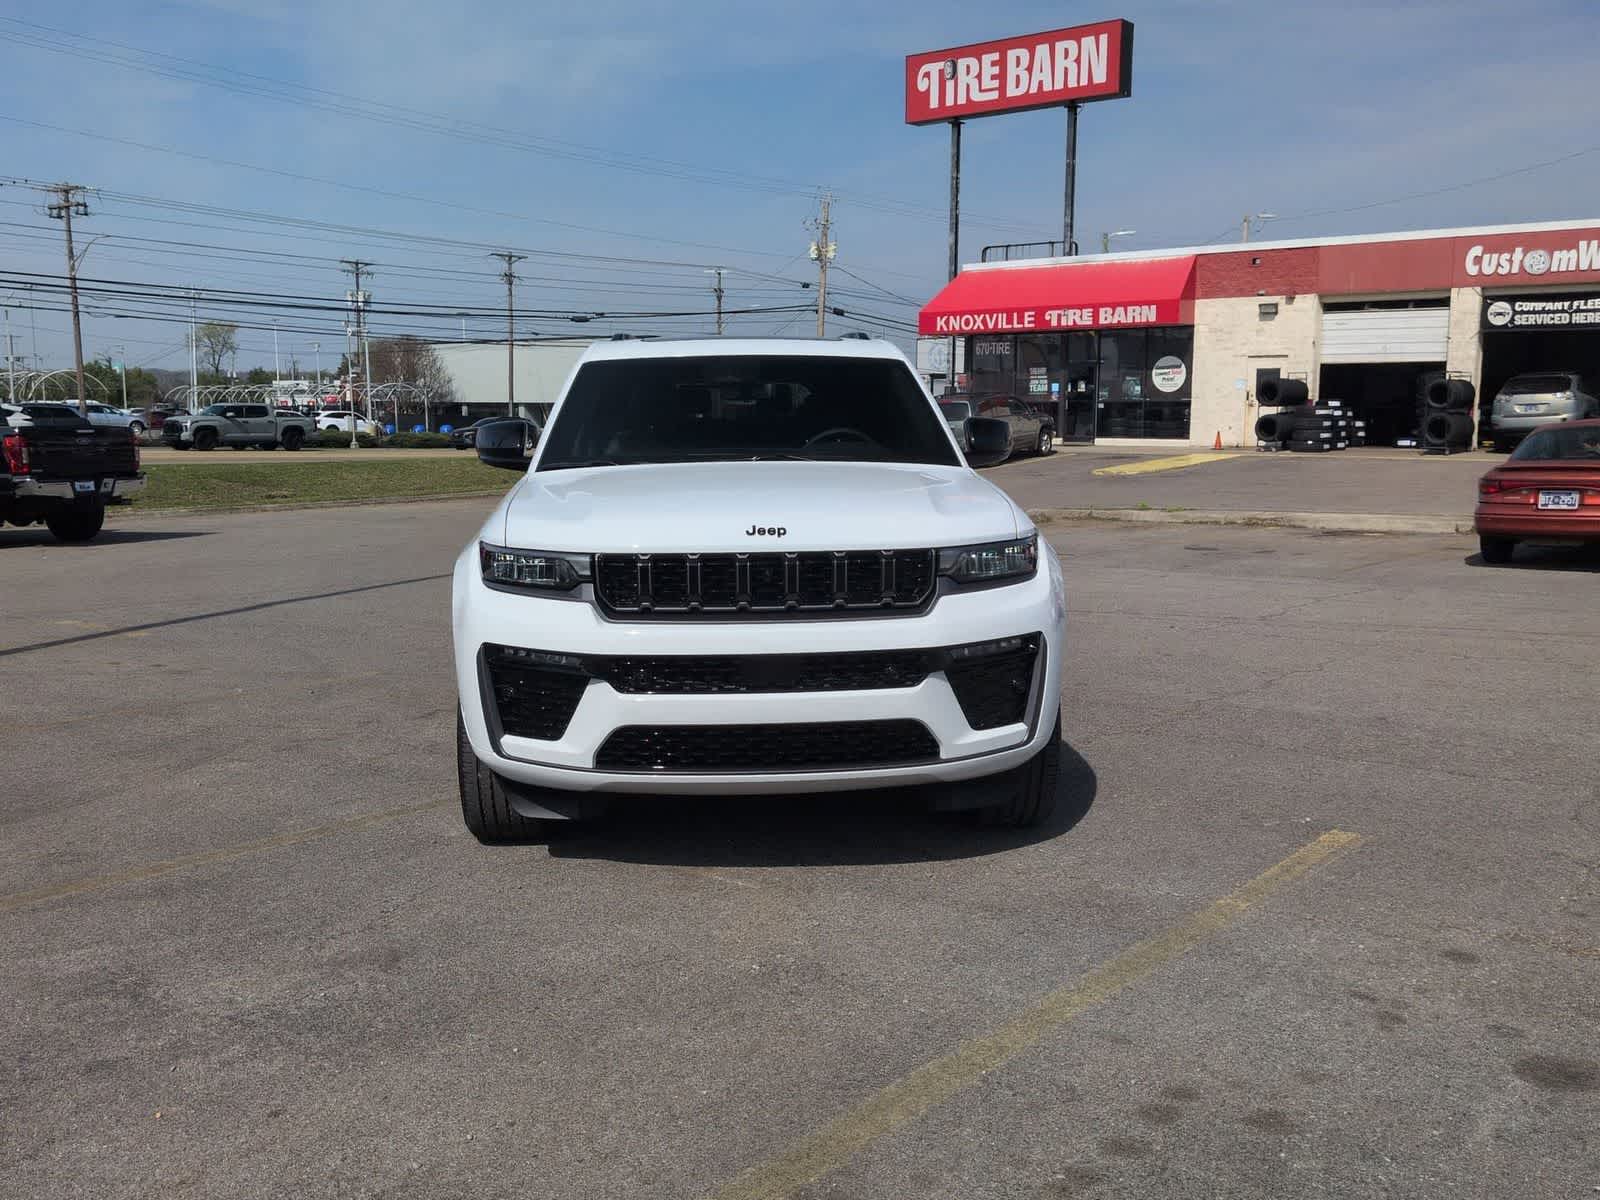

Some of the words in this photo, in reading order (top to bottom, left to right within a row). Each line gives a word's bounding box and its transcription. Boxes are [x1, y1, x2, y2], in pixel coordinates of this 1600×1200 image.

[1006, 33, 1108, 98] BARN
[1514, 301, 1570, 311] COMPANY
[936, 312, 1035, 331] KNOXVILLE
[1099, 305, 1156, 323] BARN
[1514, 314, 1569, 325] SERVICED
[1571, 312, 1600, 324] HERE
[745, 525, 787, 538] Jeep
